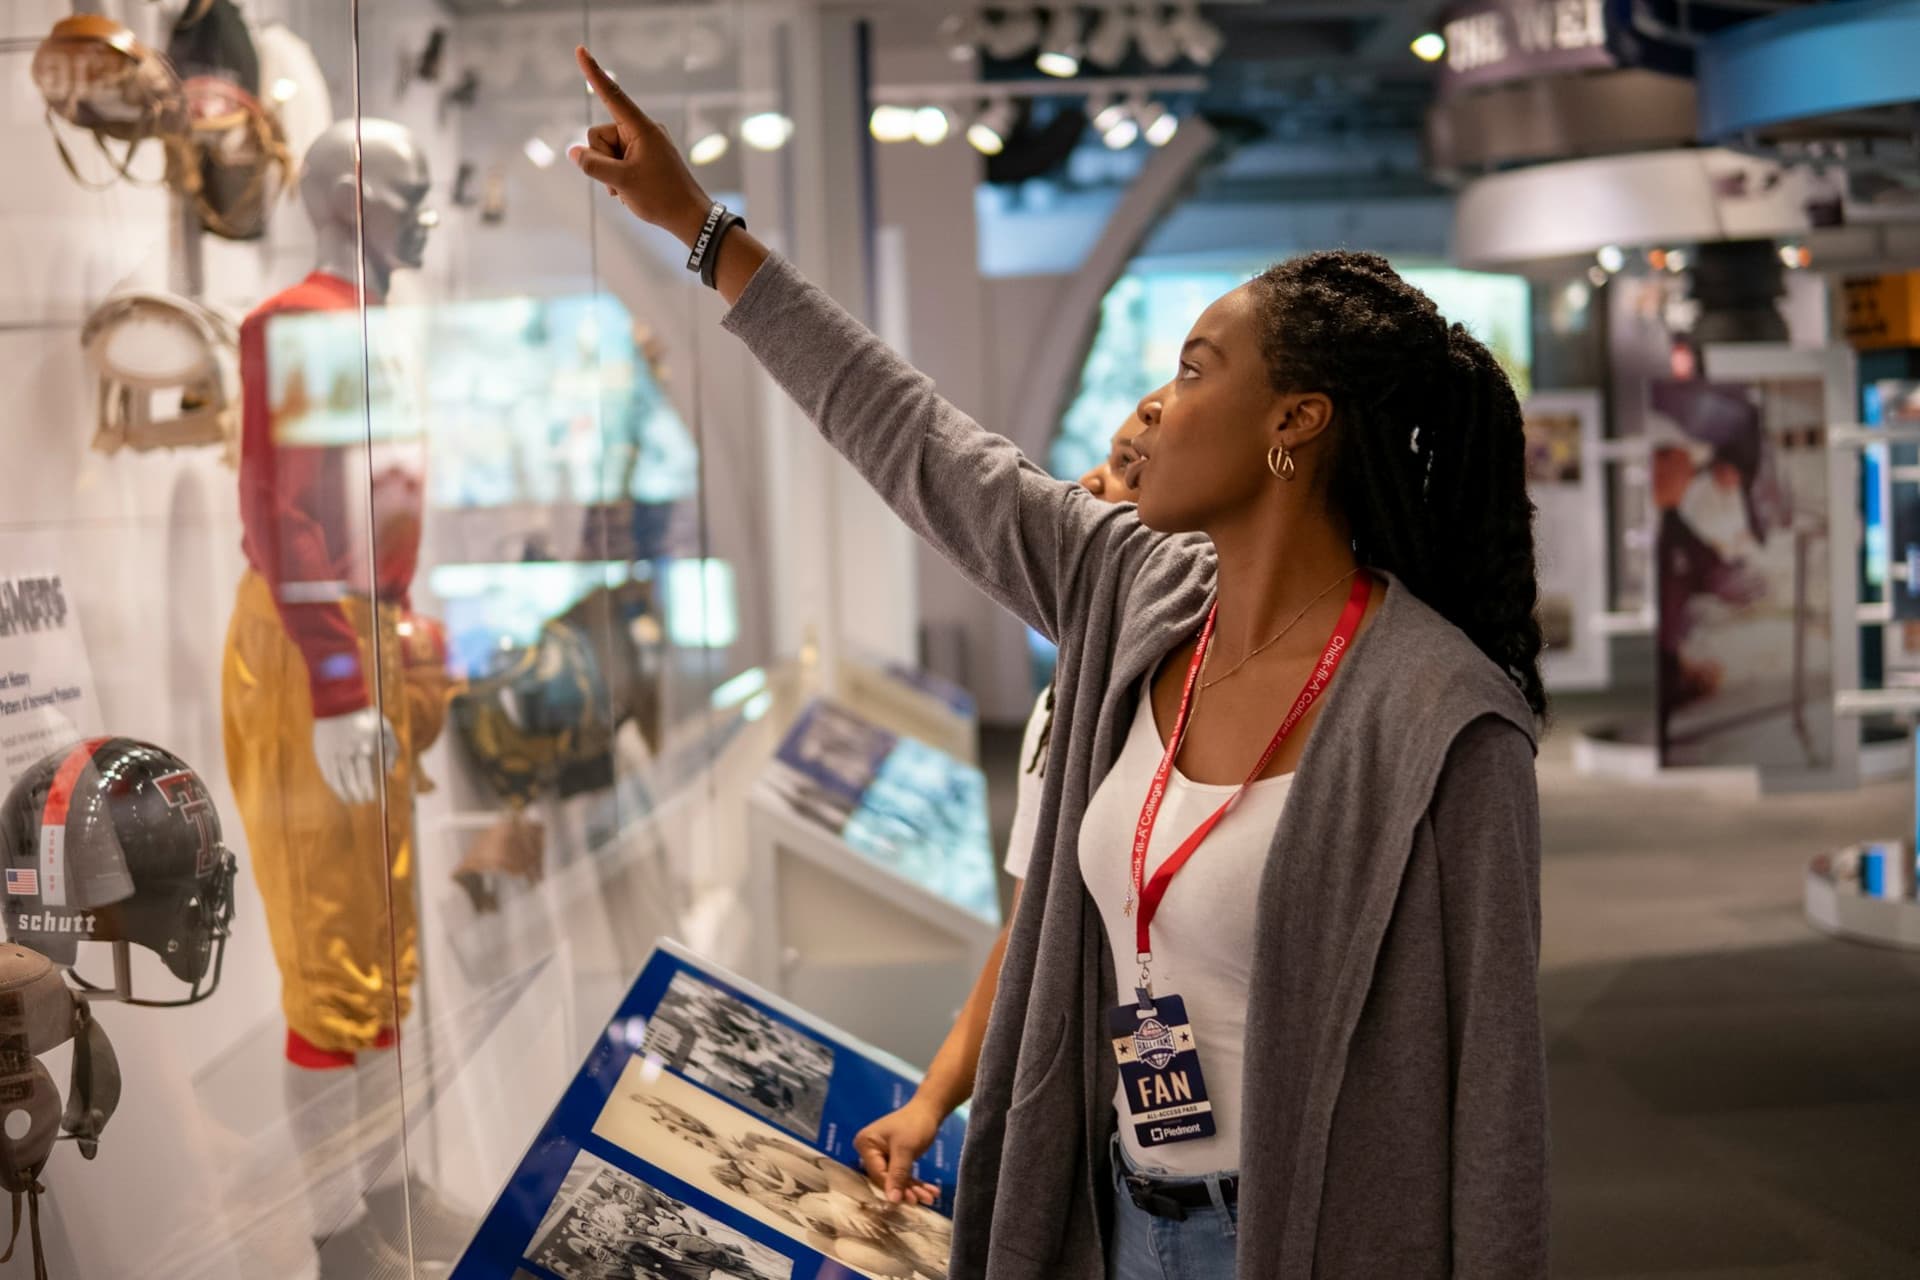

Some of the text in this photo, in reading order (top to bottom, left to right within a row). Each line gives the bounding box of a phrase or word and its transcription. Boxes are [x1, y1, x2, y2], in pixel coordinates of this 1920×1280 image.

[690, 232, 710, 266] BLACK
[1308, 635, 1345, 690] Chick-fil-A
[1141, 783, 1162, 826] College
[19, 910, 97, 933] schutt
[1137, 1070, 1192, 1108] FAN
[1163, 1123, 1201, 1138] Piedmont
